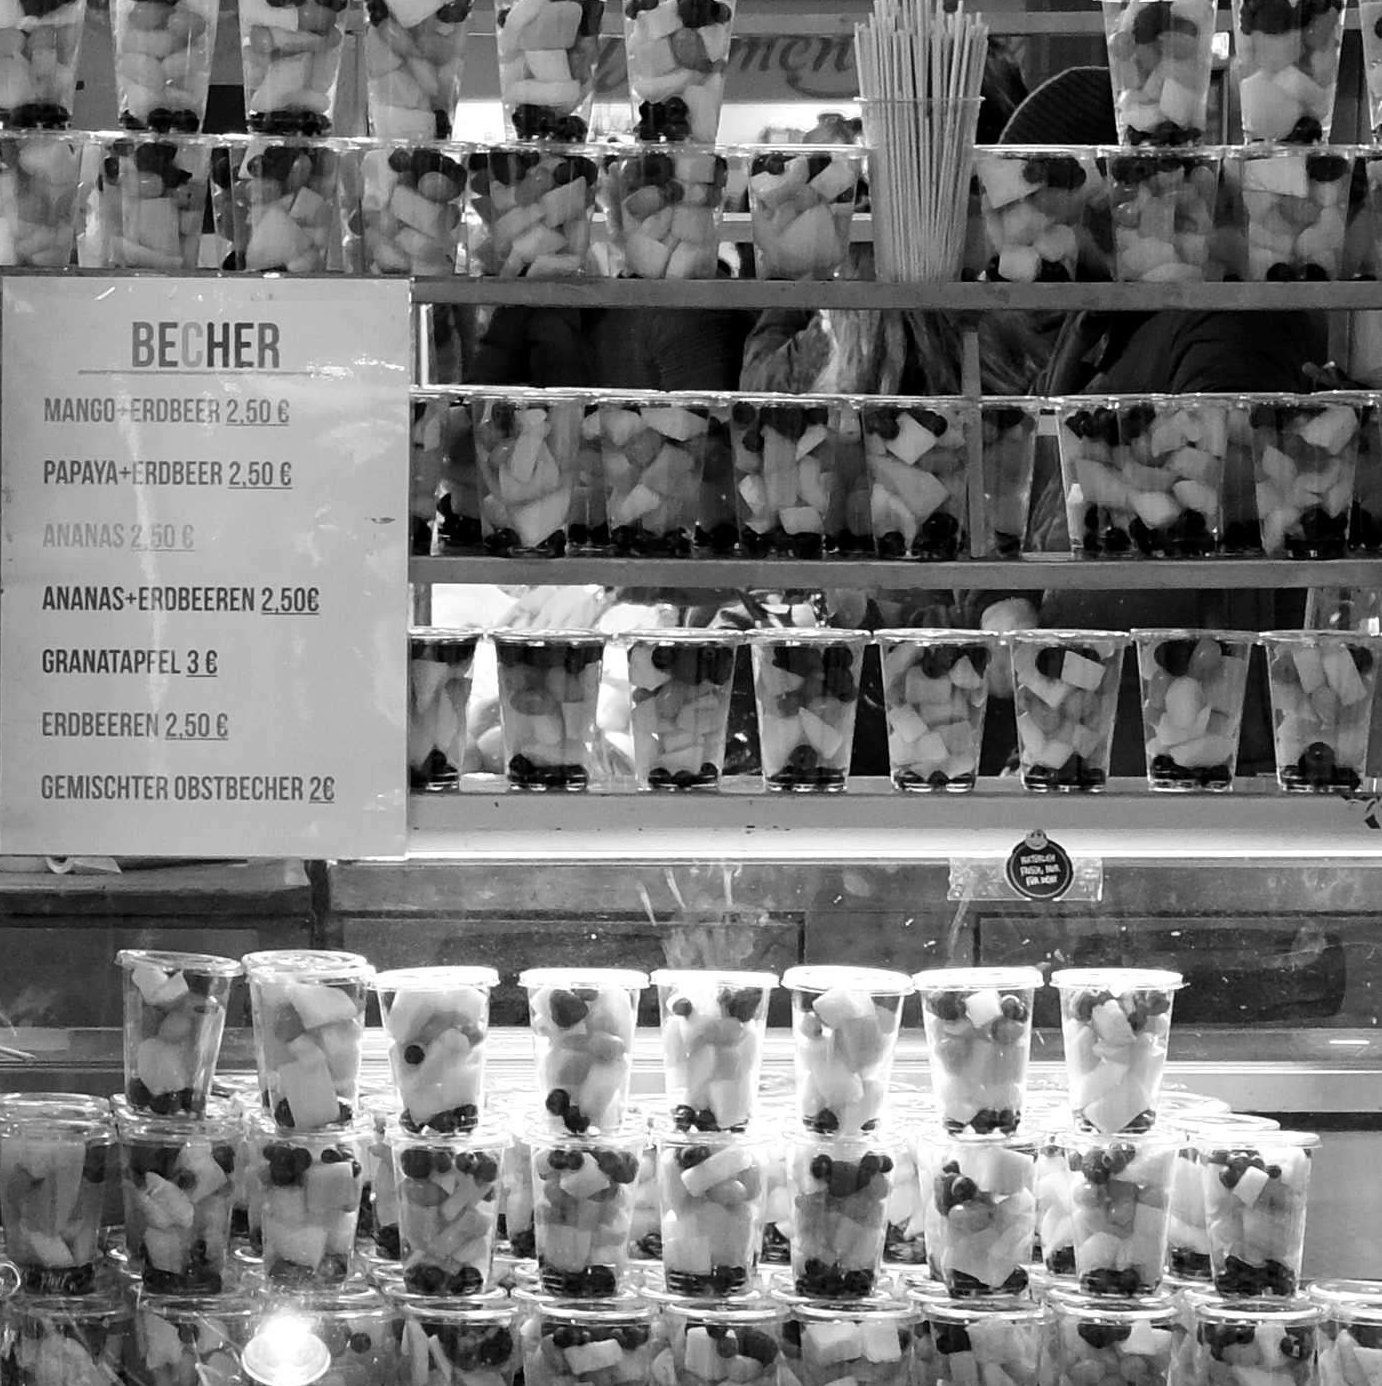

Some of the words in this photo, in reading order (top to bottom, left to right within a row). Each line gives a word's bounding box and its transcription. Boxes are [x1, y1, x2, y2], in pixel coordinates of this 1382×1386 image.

[132, 321, 280, 369] BECHER
[44, 398, 221, 424] MANGO+ERDBEER
[226, 398, 274, 425] 2,50
[277, 399, 290, 424] €
[43, 460, 223, 486] PAPAYA+ERDBEER
[228, 460, 275, 487] 2,50
[279, 461, 292, 486] €
[42, 523, 125, 549] ANANAS
[130, 523, 177, 550] 2,50
[181, 524, 195, 549] €
[42, 586, 255, 612] ANANAS+ERDBEEREN
[261, 586, 320, 613] 2,50€
[42, 649, 181, 674] GRANATAPFEL
[187, 649, 199, 674] 3
[205, 649, 218, 674] €
[42, 712, 159, 738] ERDBEEREN
[165, 712, 212, 739] 2,50
[216, 713, 229, 738] €
[41, 775, 169, 802] GEMISCHTER
[173, 776, 305, 802] OBSTBECHER
[309, 776, 335, 802] 2€
